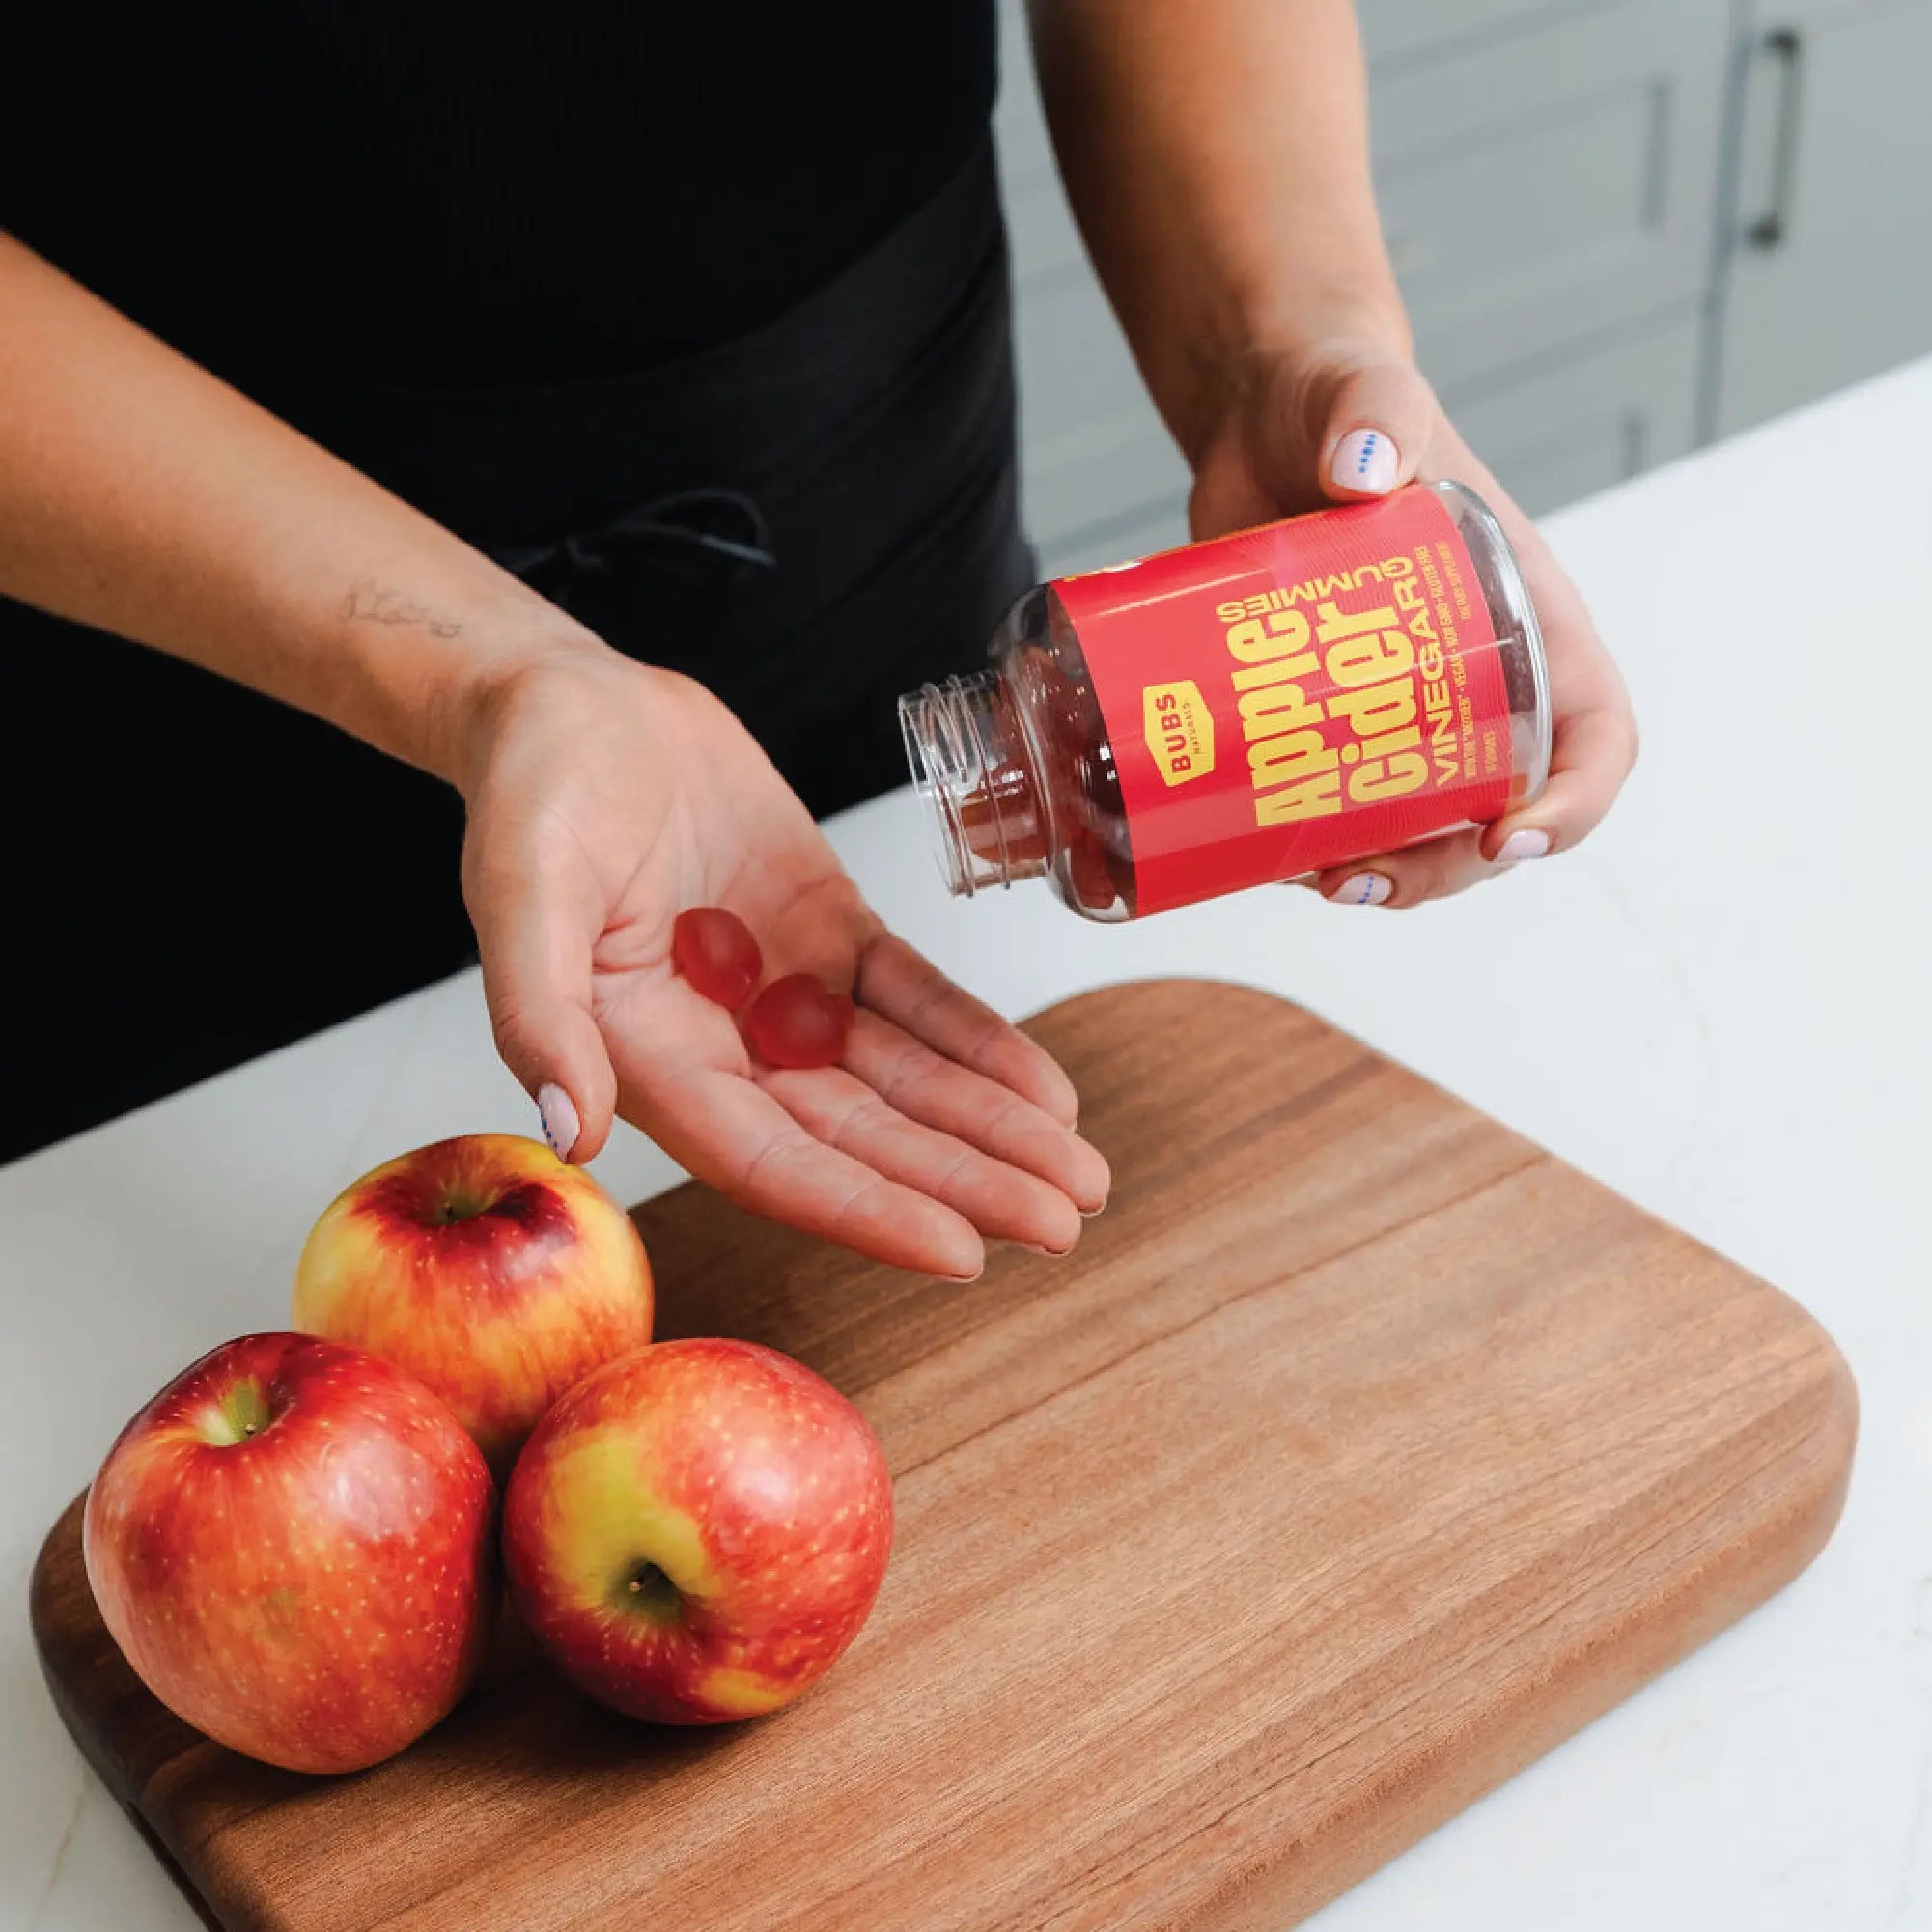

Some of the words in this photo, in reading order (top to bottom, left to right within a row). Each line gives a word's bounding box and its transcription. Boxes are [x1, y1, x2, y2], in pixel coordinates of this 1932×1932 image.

[1216, 557, 1413, 622] GUMMIES
[1393, 576, 1459, 787] VINEGAR
[1155, 694, 1191, 773] BUBS
[1226, 609, 1342, 826] Apple
[1316, 602, 1429, 802] Cider
